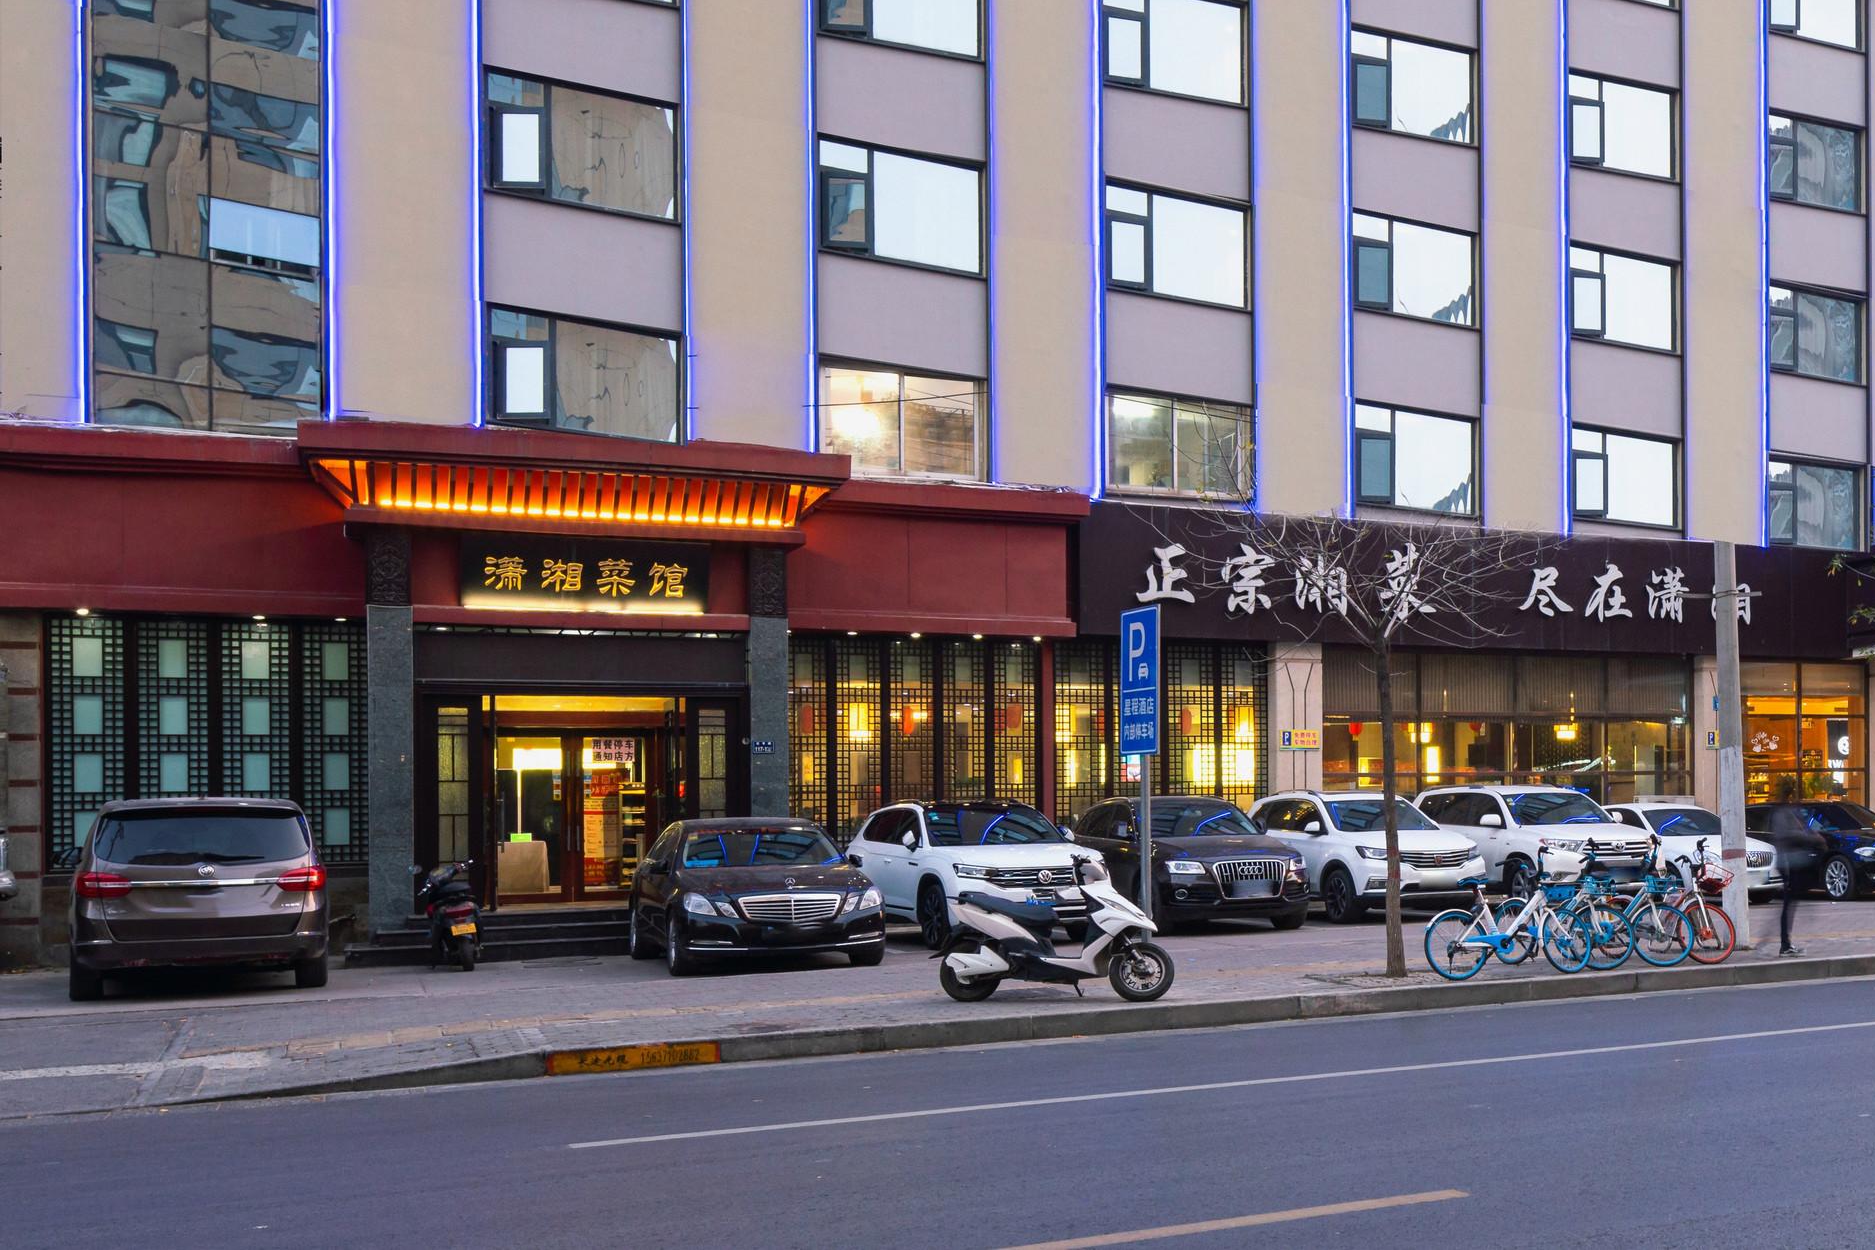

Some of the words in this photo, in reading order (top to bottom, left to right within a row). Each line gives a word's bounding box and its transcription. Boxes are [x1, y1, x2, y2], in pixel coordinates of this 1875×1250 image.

[484, 555, 689, 599] 潇湘菜馆
[1135, 542, 1438, 624] 正宗湘菜
[1128, 621, 1146, 683] P
[1123, 696, 1155, 717] 星程酒店
[1123, 720, 1155, 741] 内部停车场
[592, 738, 635, 751] 用餐停车
[592, 751, 635, 762] 通知店方
